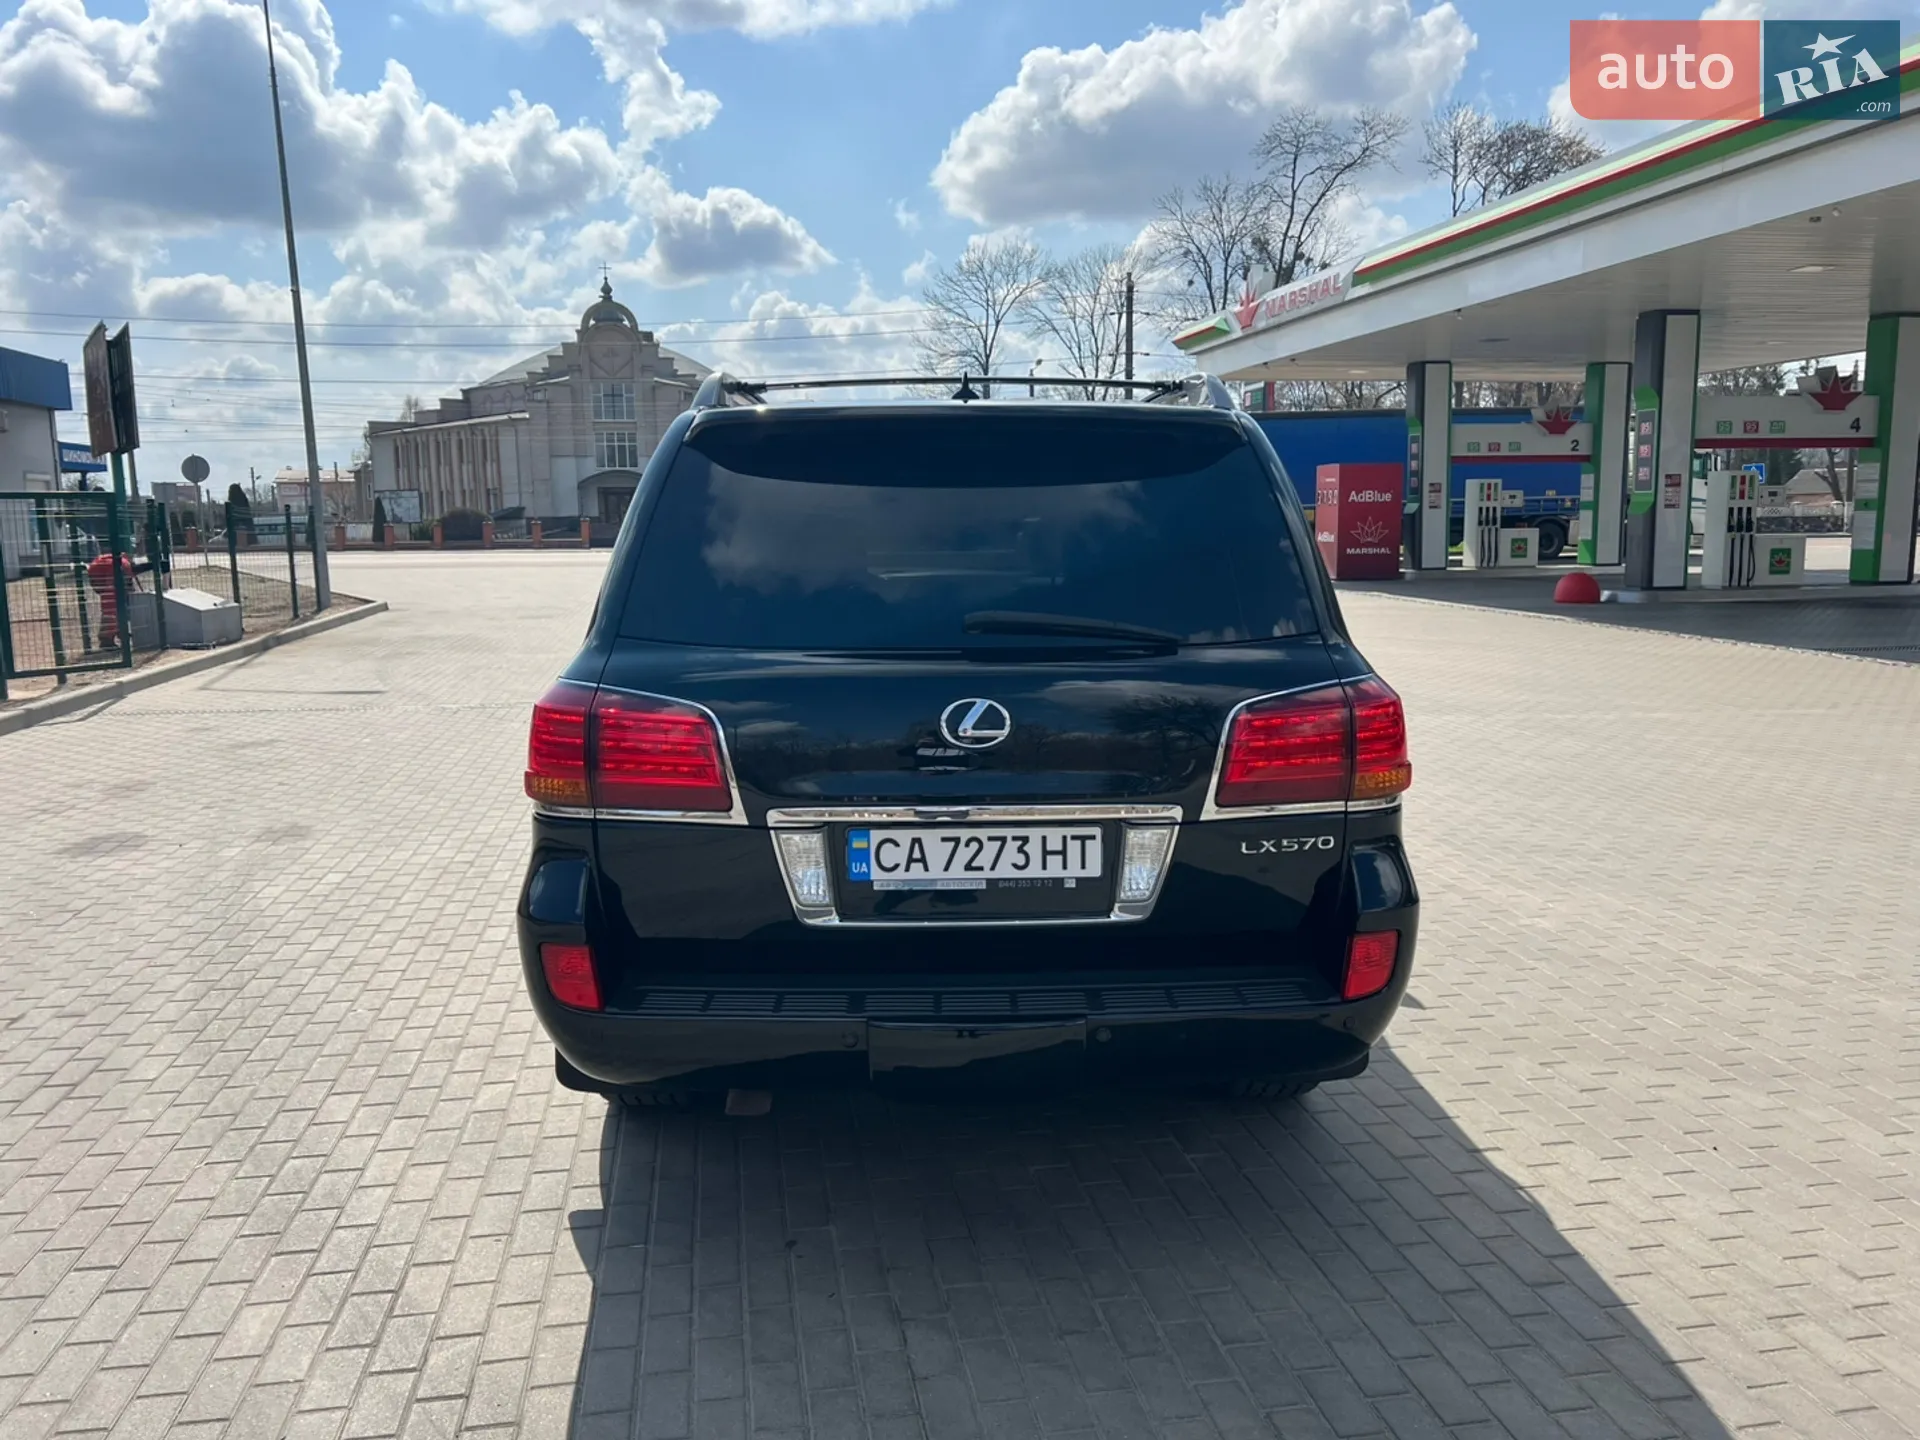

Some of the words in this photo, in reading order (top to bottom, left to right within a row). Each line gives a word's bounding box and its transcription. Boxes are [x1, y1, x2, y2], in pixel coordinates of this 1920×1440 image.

[1265, 271, 1343, 319] MARSHAL
[1850, 417, 1861, 433] 4
[1571, 439, 1579, 451] 2
[1348, 490, 1392, 502] AdBlue
[1346, 547, 1391, 555] MARSHAL
[874, 837, 930, 873] CA
[940, 835, 1030, 872] 7273
[1041, 834, 1096, 870] HT
[852, 862, 868, 873] UA
